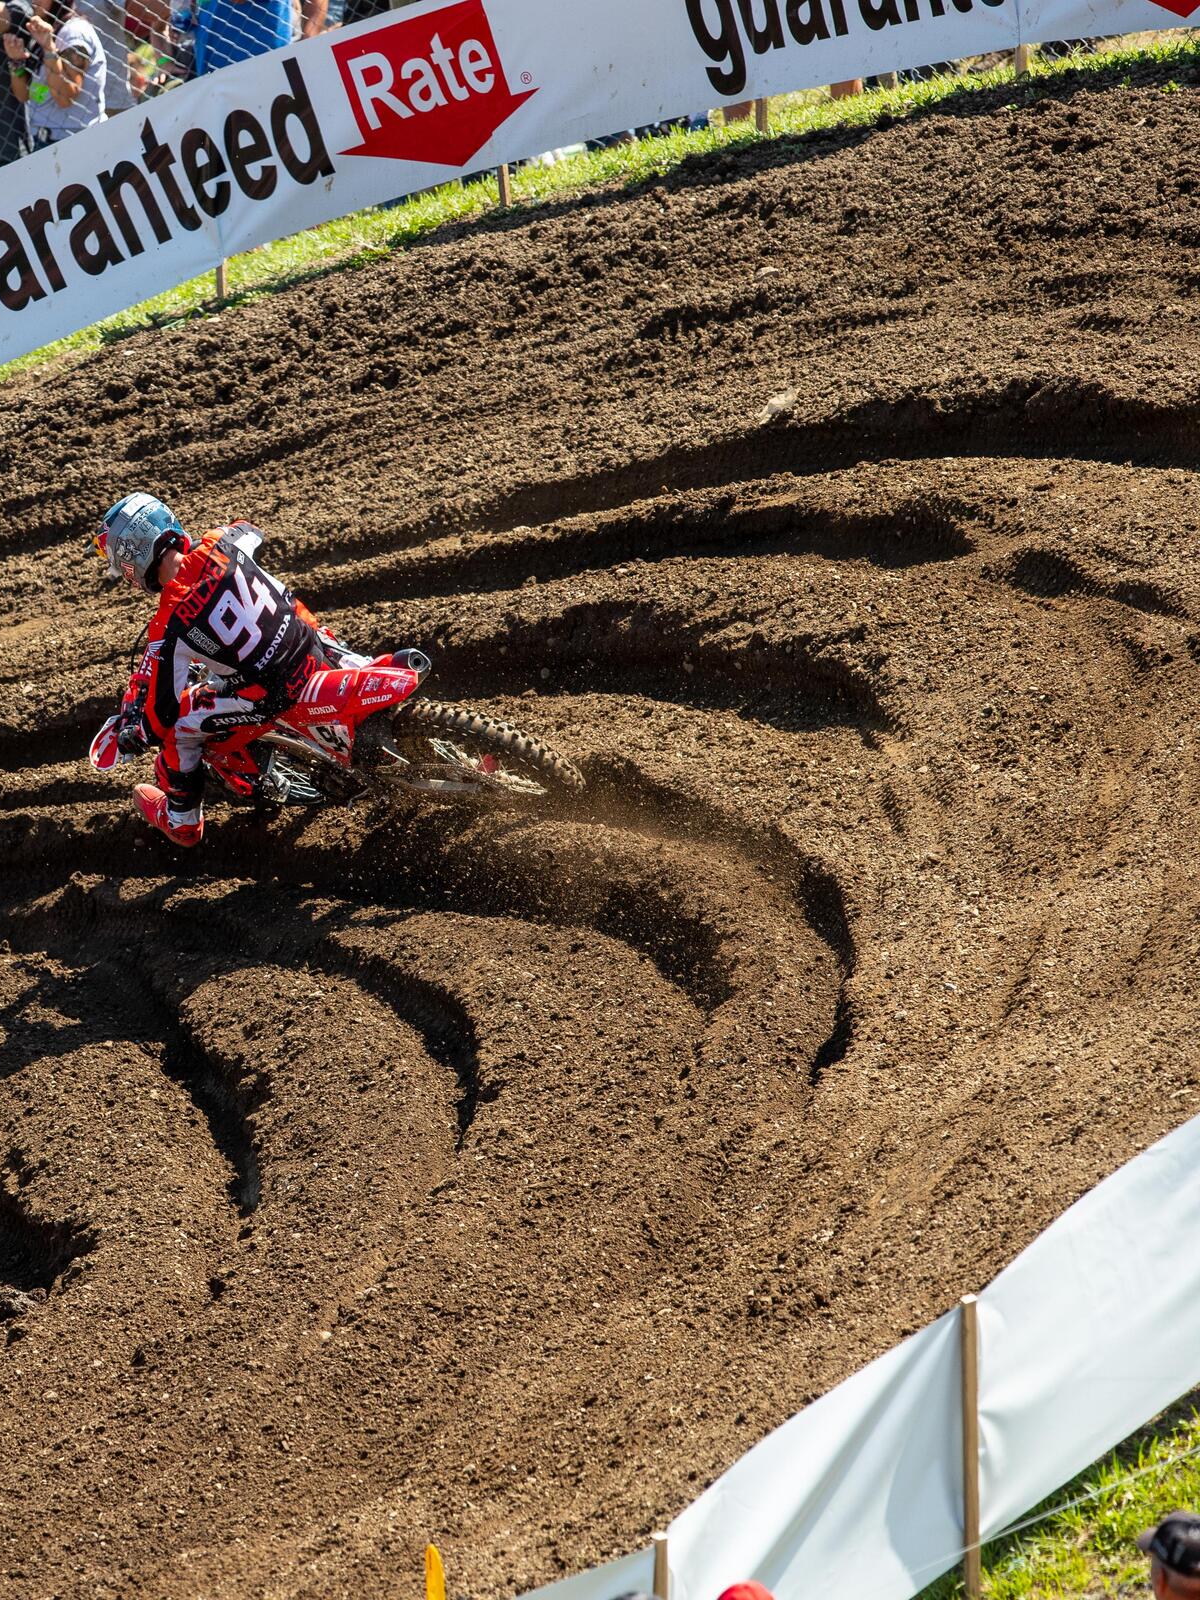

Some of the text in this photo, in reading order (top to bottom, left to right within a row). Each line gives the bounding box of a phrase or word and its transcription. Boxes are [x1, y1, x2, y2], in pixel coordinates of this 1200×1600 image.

[346, 32, 495, 130] Rate
[208, 564, 278, 662] 94
[253, 613, 291, 671] HONDA
[306, 704, 338, 716] HONDA
[361, 693, 393, 706] DUNLOP
[211, 713, 267, 727] HONDA
